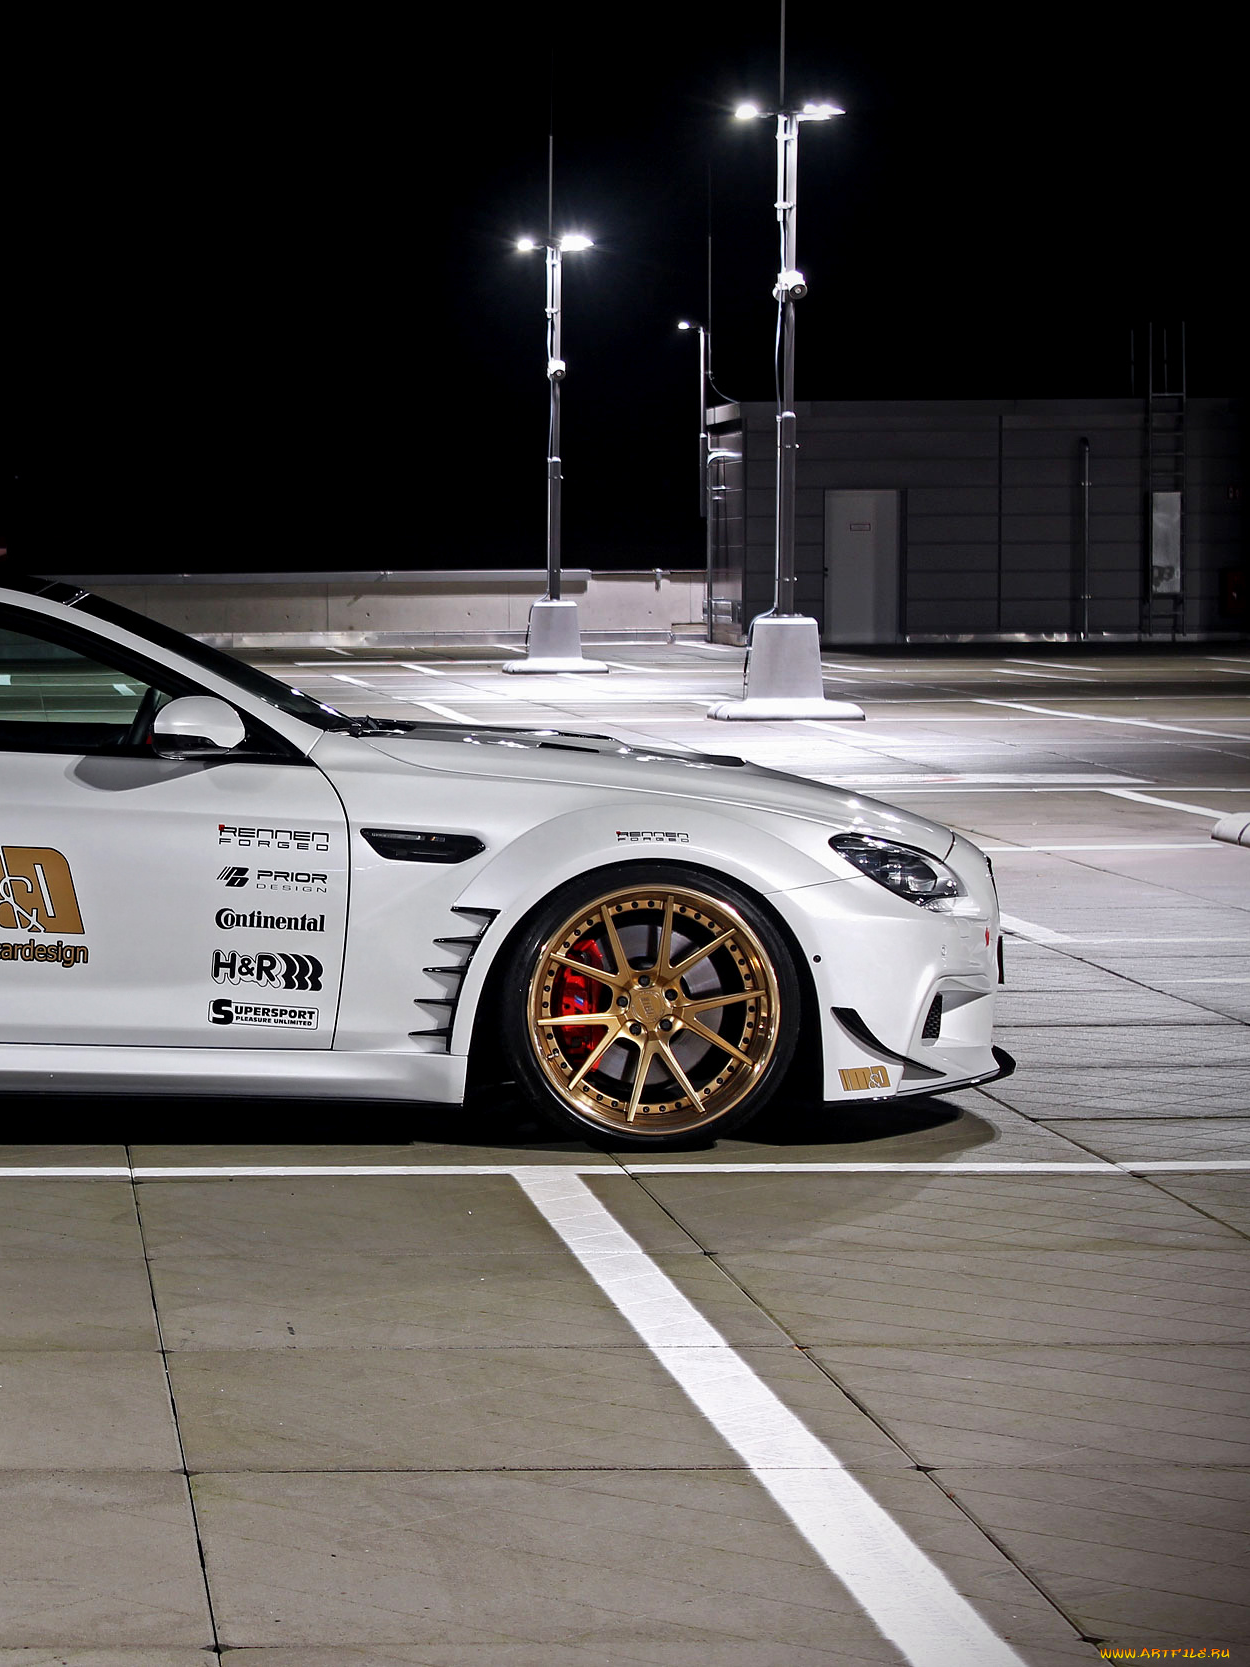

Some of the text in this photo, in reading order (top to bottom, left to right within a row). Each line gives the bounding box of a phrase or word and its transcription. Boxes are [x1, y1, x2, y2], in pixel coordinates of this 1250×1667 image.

[218, 825, 330, 842] RENNEN
[218, 838, 329, 851] FORGED
[257, 870, 328, 884] PRIOR
[256, 883, 327, 893] DESIGN
[215, 908, 326, 932] Continental
[212, 949, 282, 988] H&R
[211, 998, 316, 1025] SUPERSPORT
[235, 1015, 313, 1027] PLEASURE UNLIMITED
